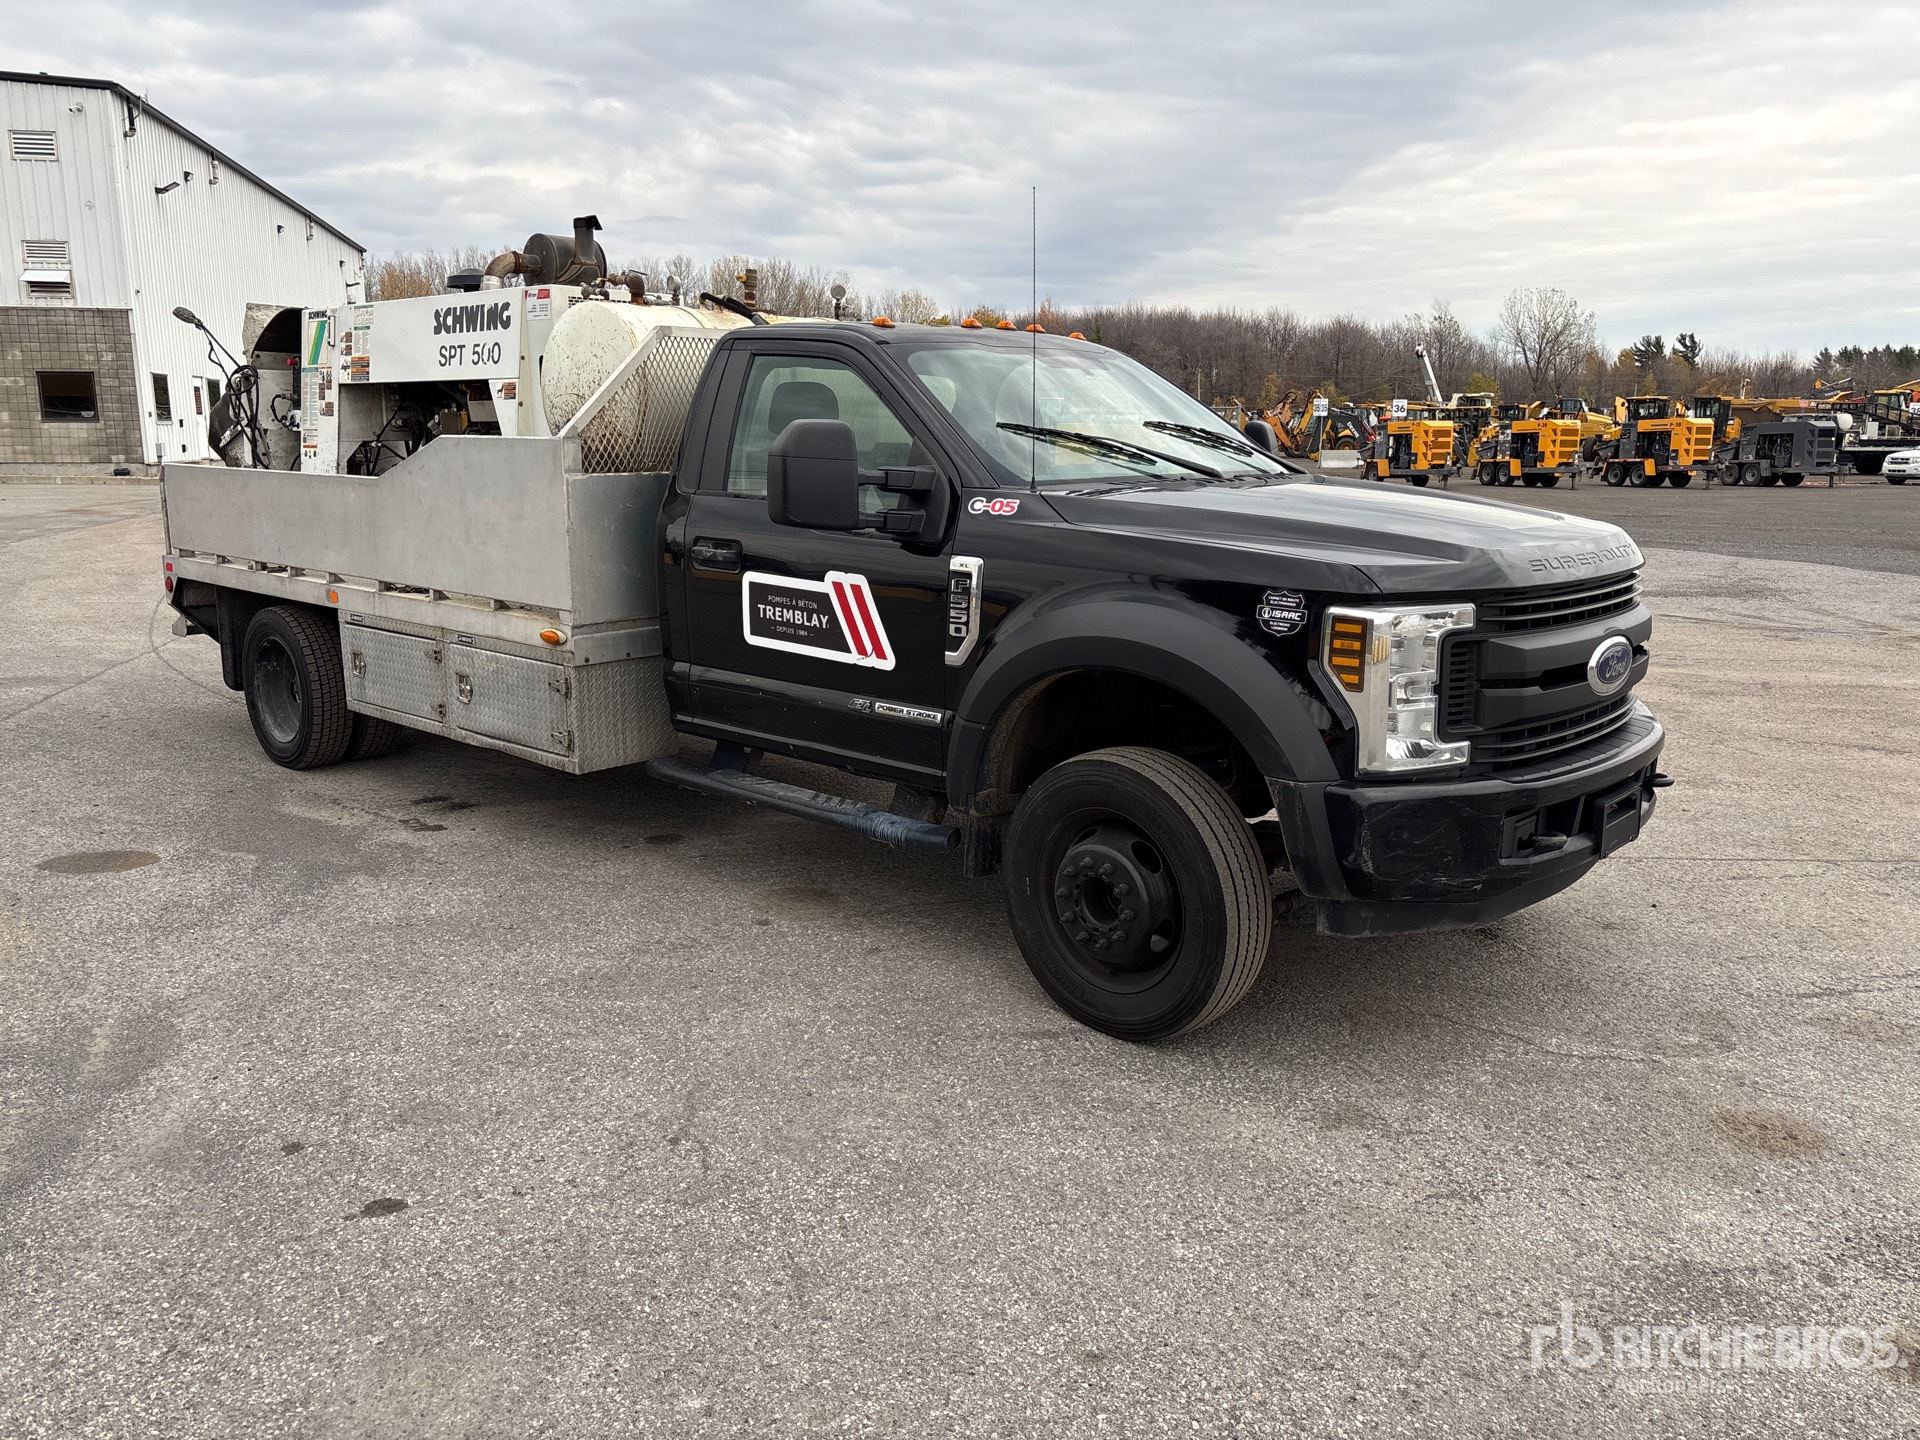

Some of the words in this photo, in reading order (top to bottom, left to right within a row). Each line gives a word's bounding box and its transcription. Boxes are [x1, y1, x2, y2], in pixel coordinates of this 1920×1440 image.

[433, 301, 512, 336] SCHWING
[438, 344, 466, 368] SPT
[471, 341, 502, 366] 500
[1394, 404, 1406, 413] 36
[1346, 421, 1360, 438] DEERE
[968, 497, 1020, 515] C-05
[1528, 551, 1604, 573] SUPER
[1600, 543, 1637, 560] DUTY
[767, 594, 791, 605] POMPES
[797, 598, 818, 610] BÉTON
[757, 603, 829, 629] TREMBLAY
[1272, 610, 1302, 620] ISAAC
[776, 625, 795, 635] DEPUIS
[1605, 648, 1628, 679] Ford
[876, 703, 905, 715] POWER
[905, 709, 939, 721] STROKE
